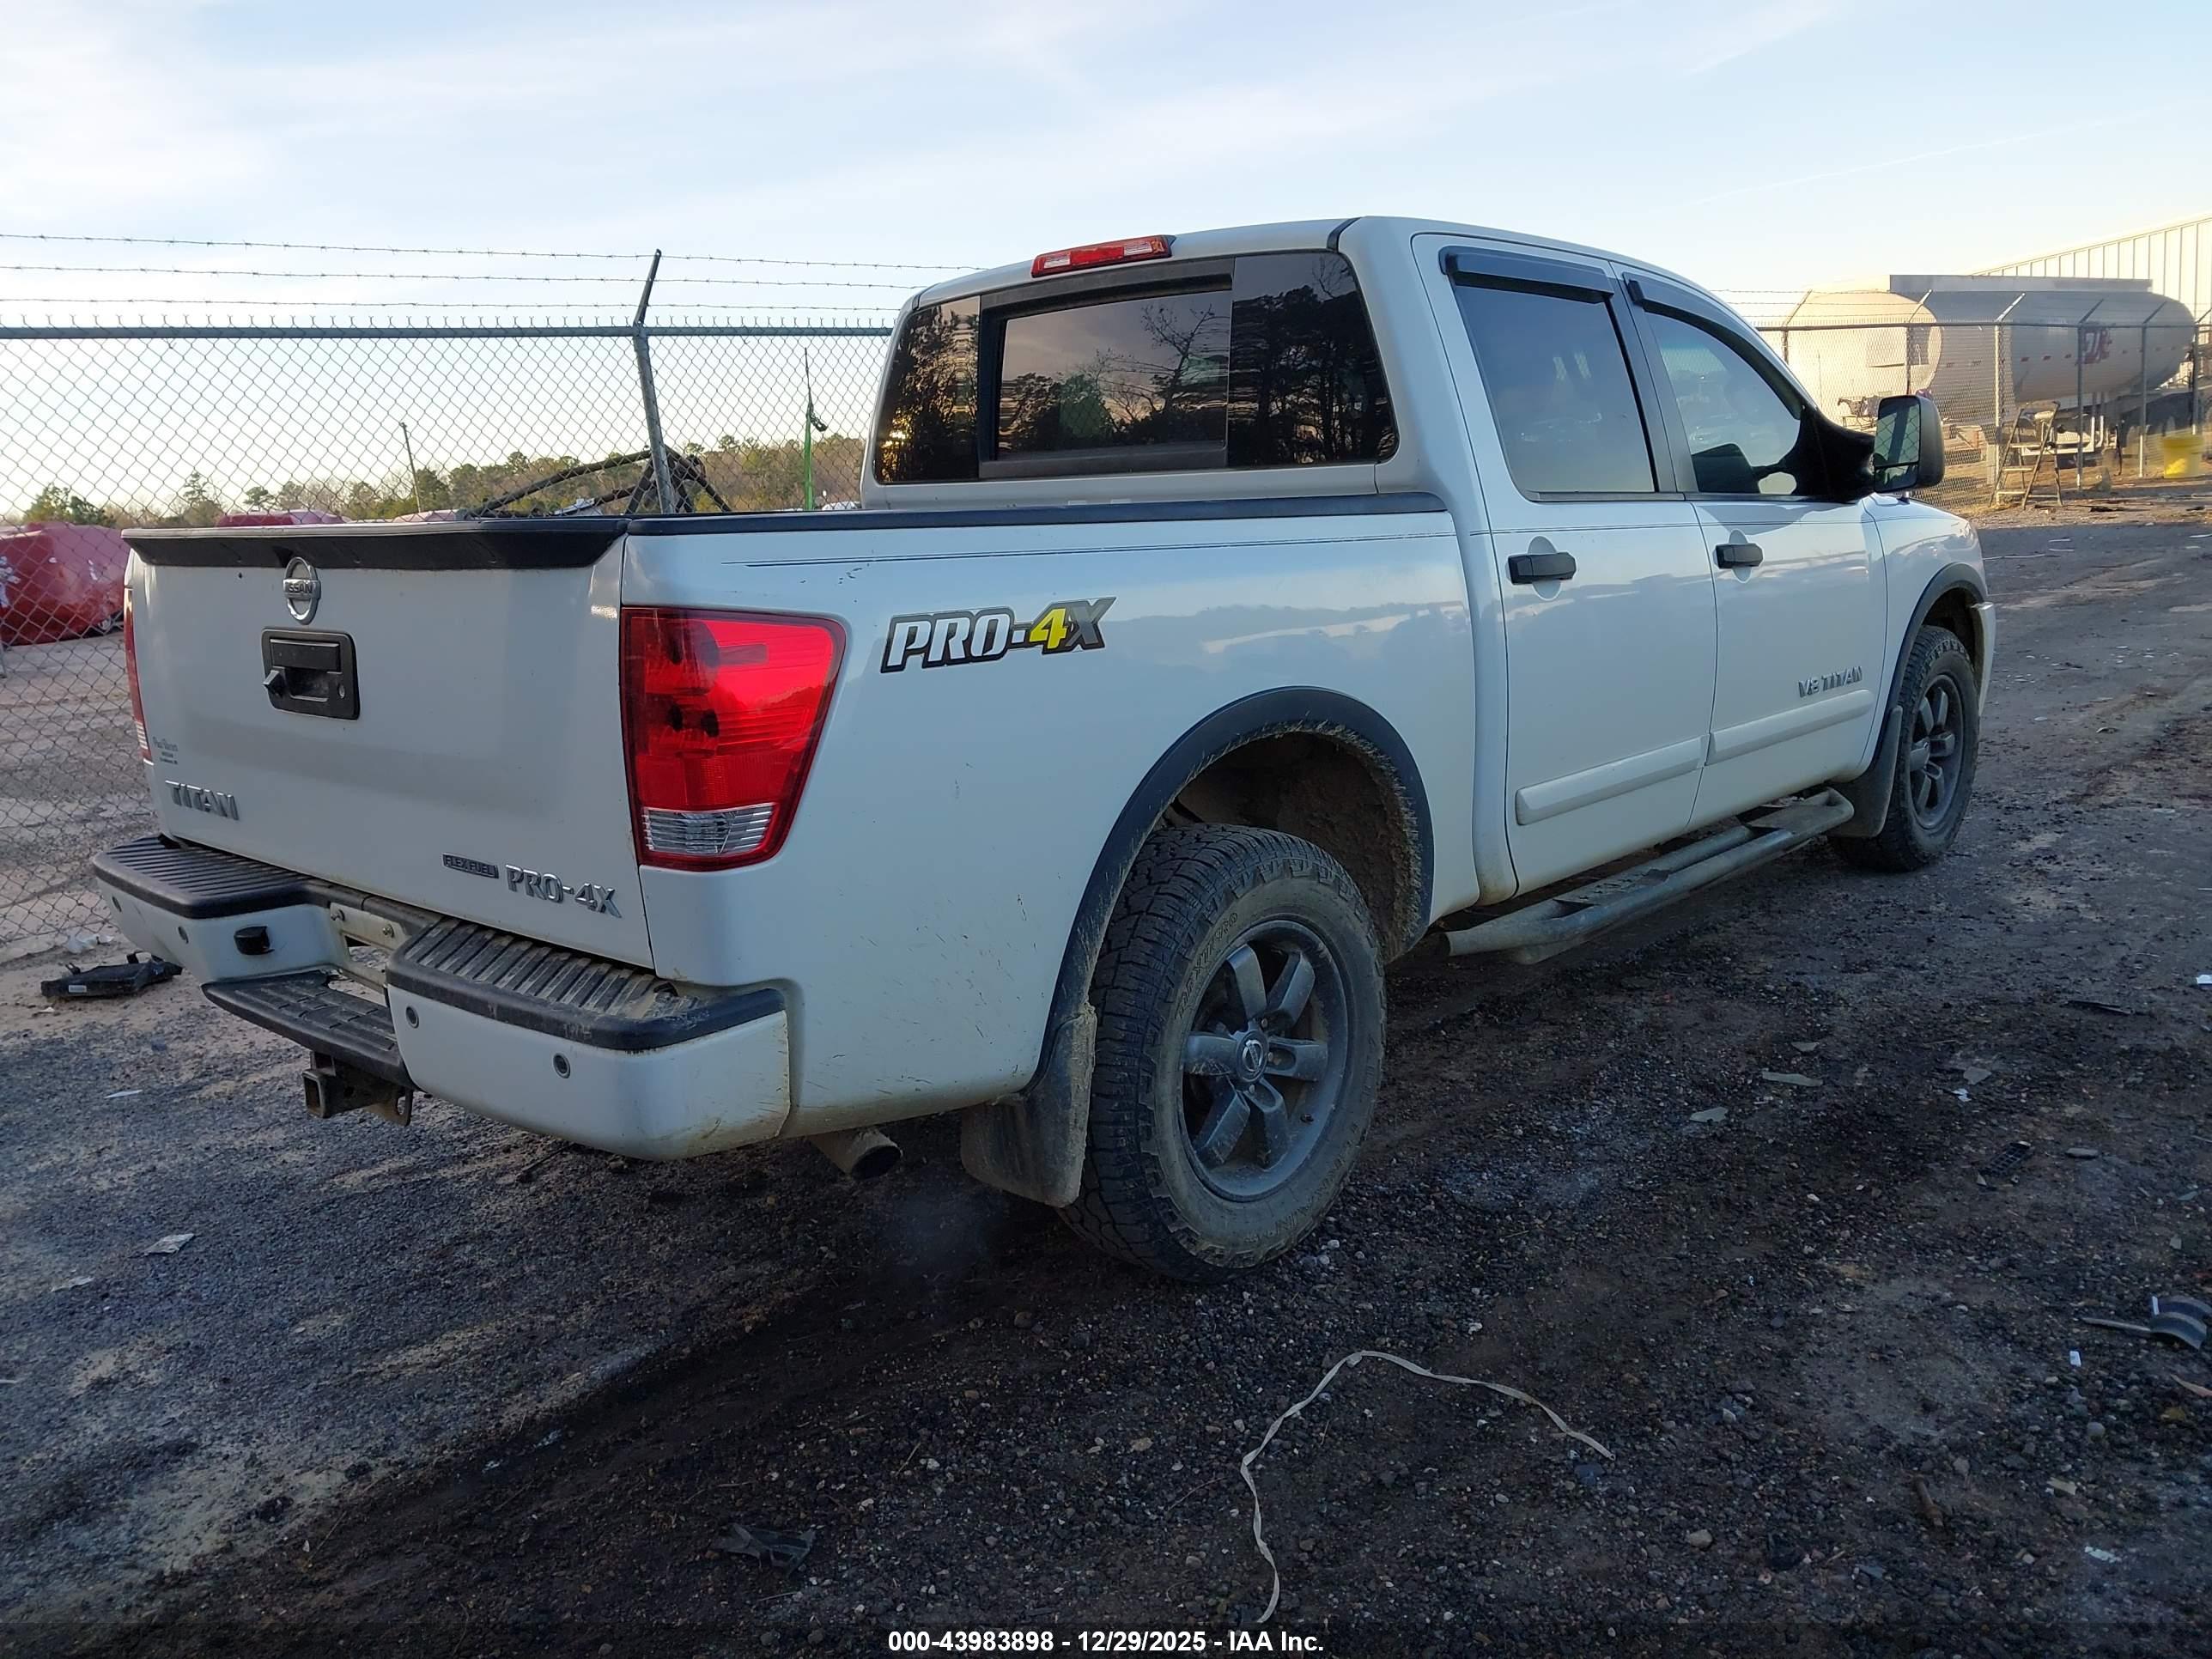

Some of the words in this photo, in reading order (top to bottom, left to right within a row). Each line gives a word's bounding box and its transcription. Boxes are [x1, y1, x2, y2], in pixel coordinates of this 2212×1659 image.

[882, 597, 1116, 673] PRO-4X
[1798, 676, 1819, 697] V8
[1821, 665, 1863, 691] TITAN
[166, 779, 240, 821] TITAN
[444, 854, 468, 871] FLEX
[469, 860, 494, 877] FUEL
[505, 864, 622, 918] PRO-4X
